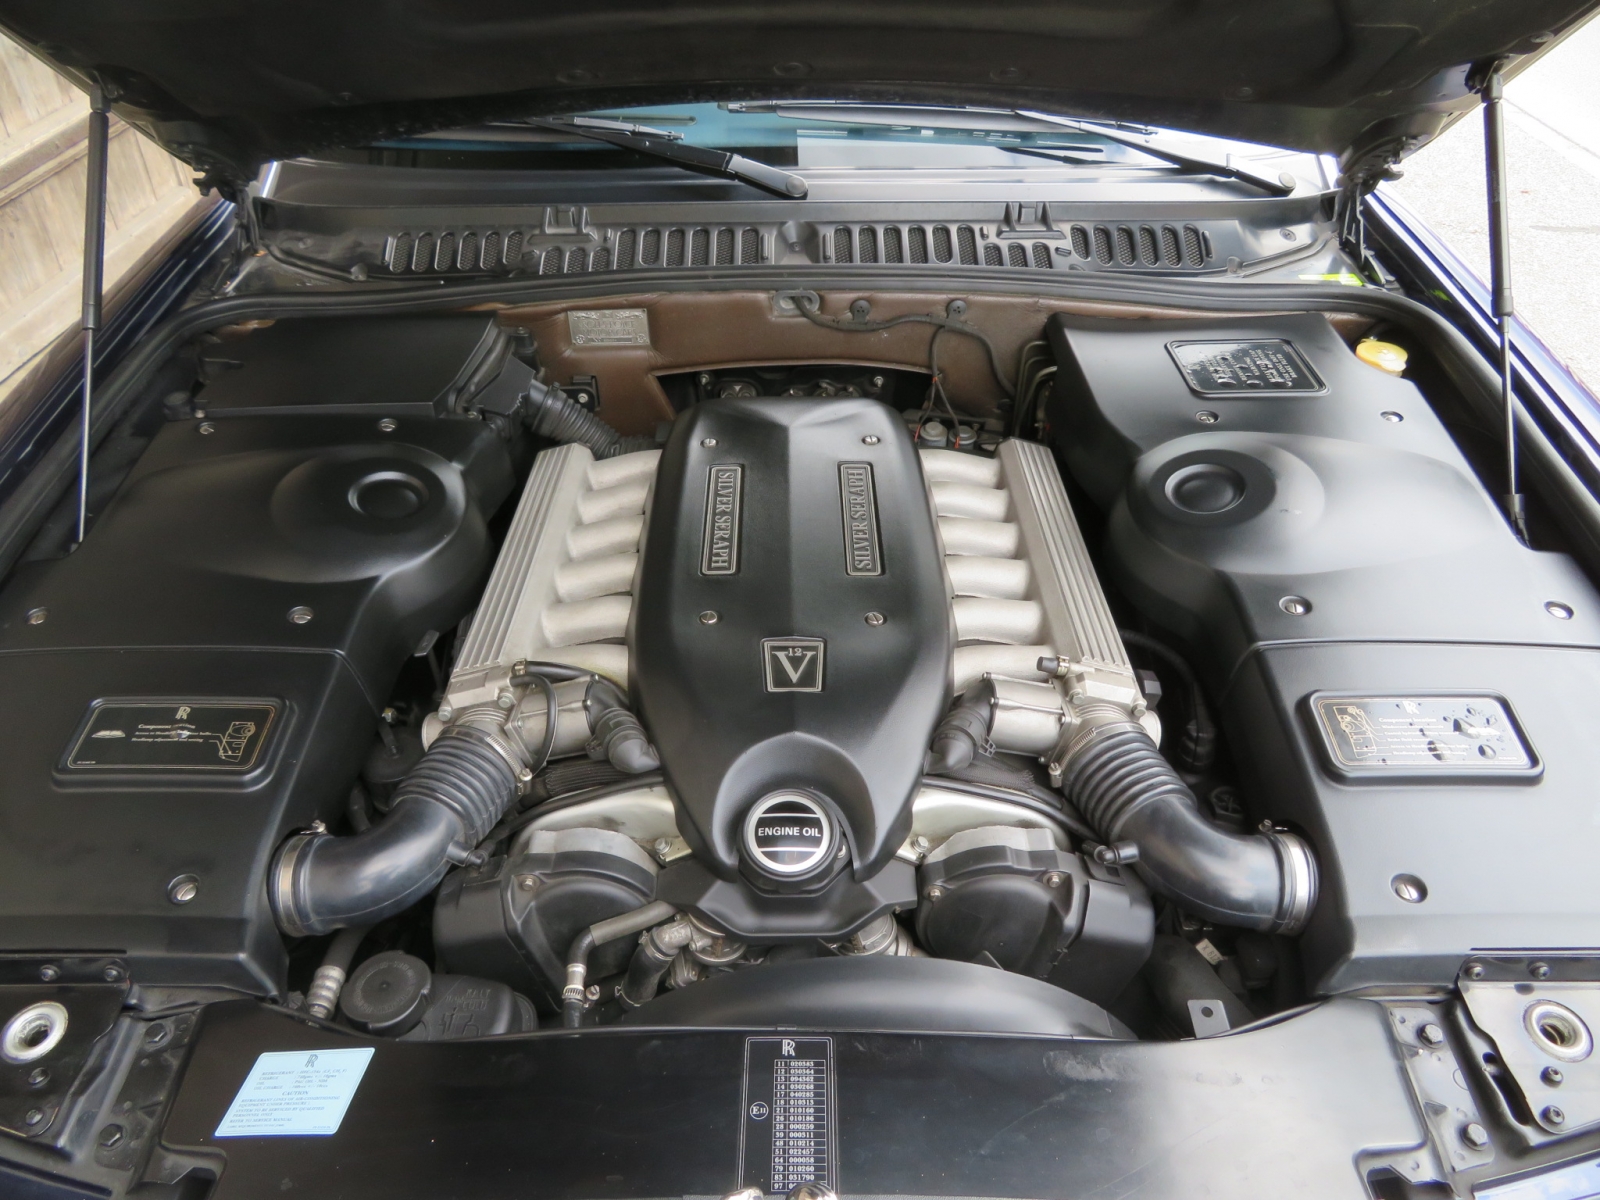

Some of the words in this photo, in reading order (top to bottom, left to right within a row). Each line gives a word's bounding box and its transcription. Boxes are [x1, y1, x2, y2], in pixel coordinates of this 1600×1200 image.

[715, 472, 735, 515] SILVER
[847, 470, 867, 520] SERAPH
[711, 516, 731, 569] SERAPH
[850, 522, 872, 570] SILVER
[758, 827, 800, 837] ENGINE
[802, 827, 822, 837] OIL
